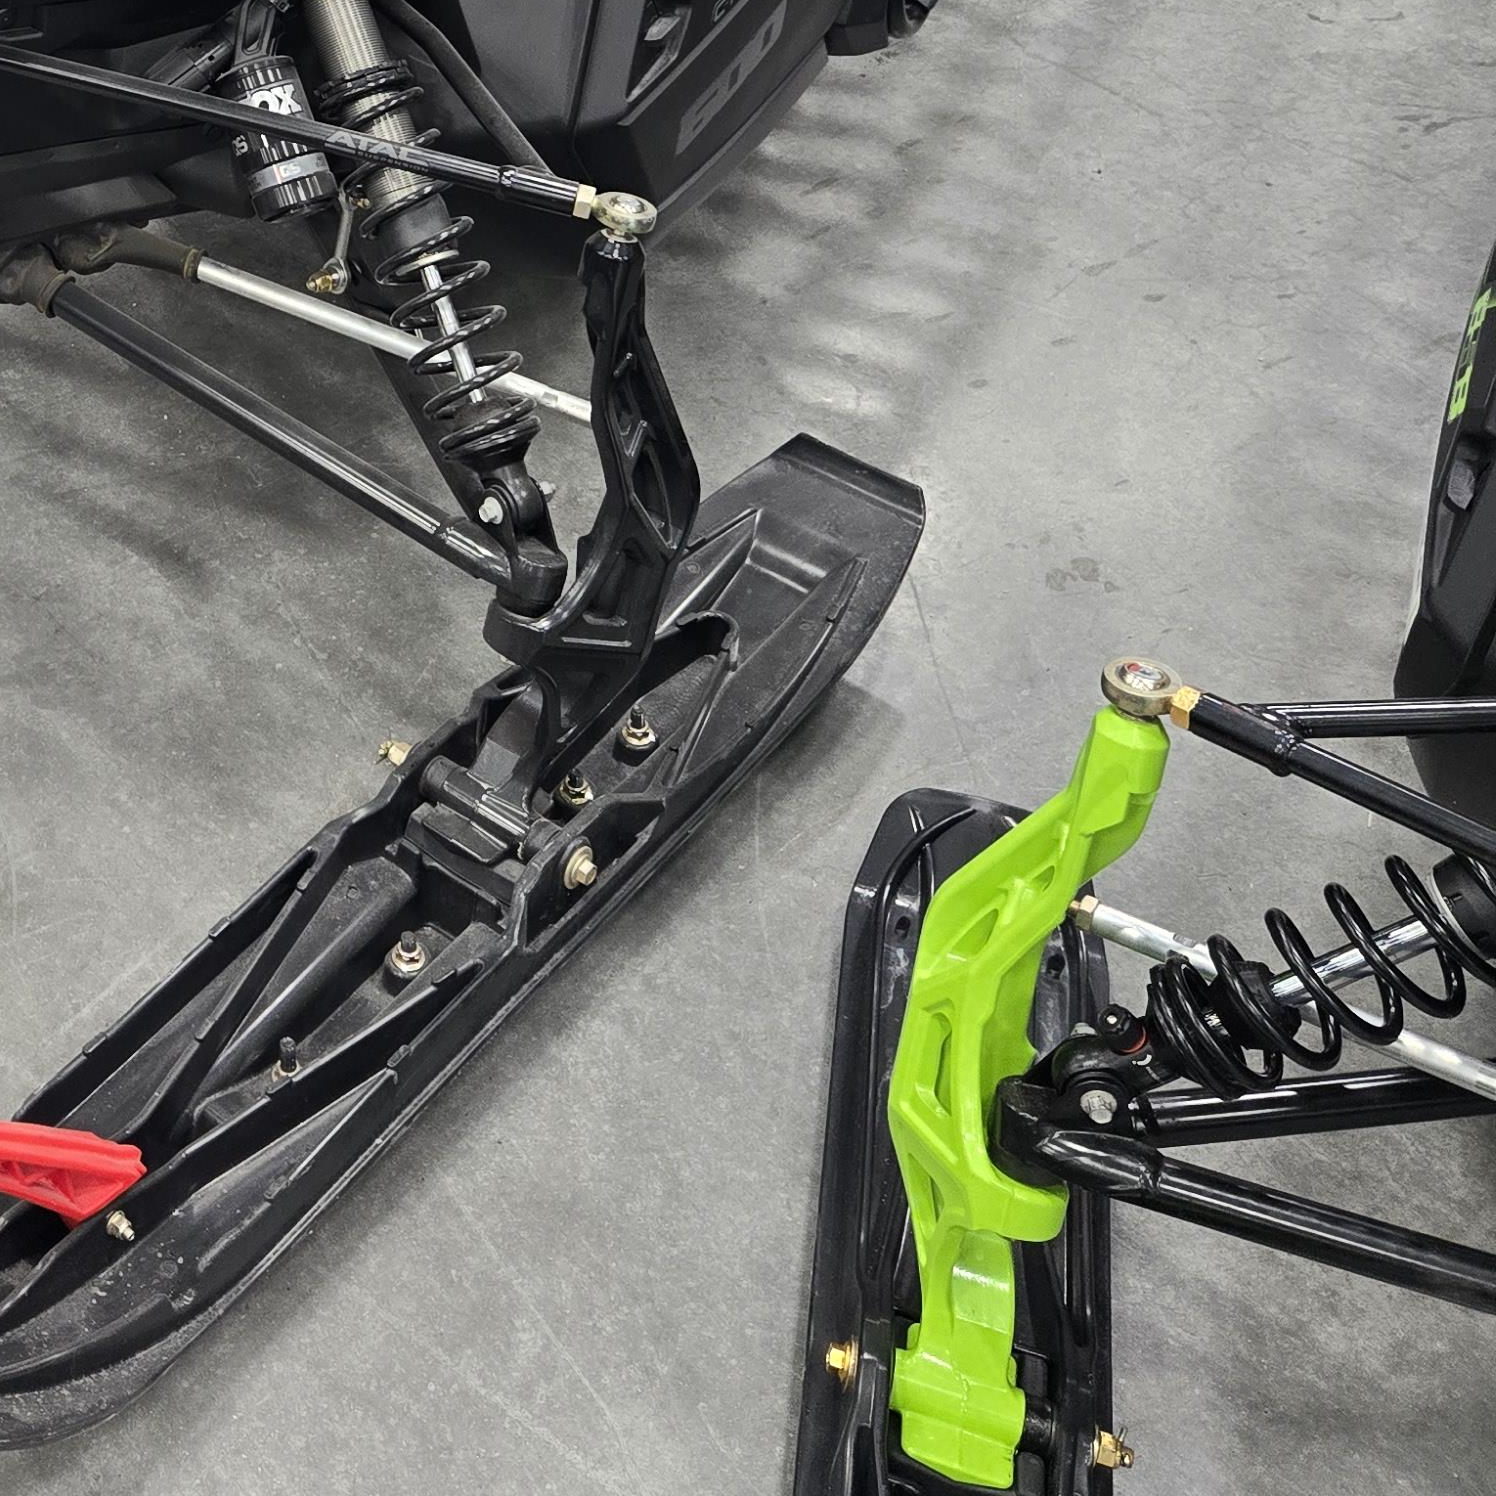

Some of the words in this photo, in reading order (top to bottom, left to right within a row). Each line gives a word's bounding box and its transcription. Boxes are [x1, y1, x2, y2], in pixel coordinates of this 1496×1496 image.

[238, 83, 303, 116] OX
[325, 130, 430, 167] ATAC
[356, 150, 430, 173] SUSPENSION
